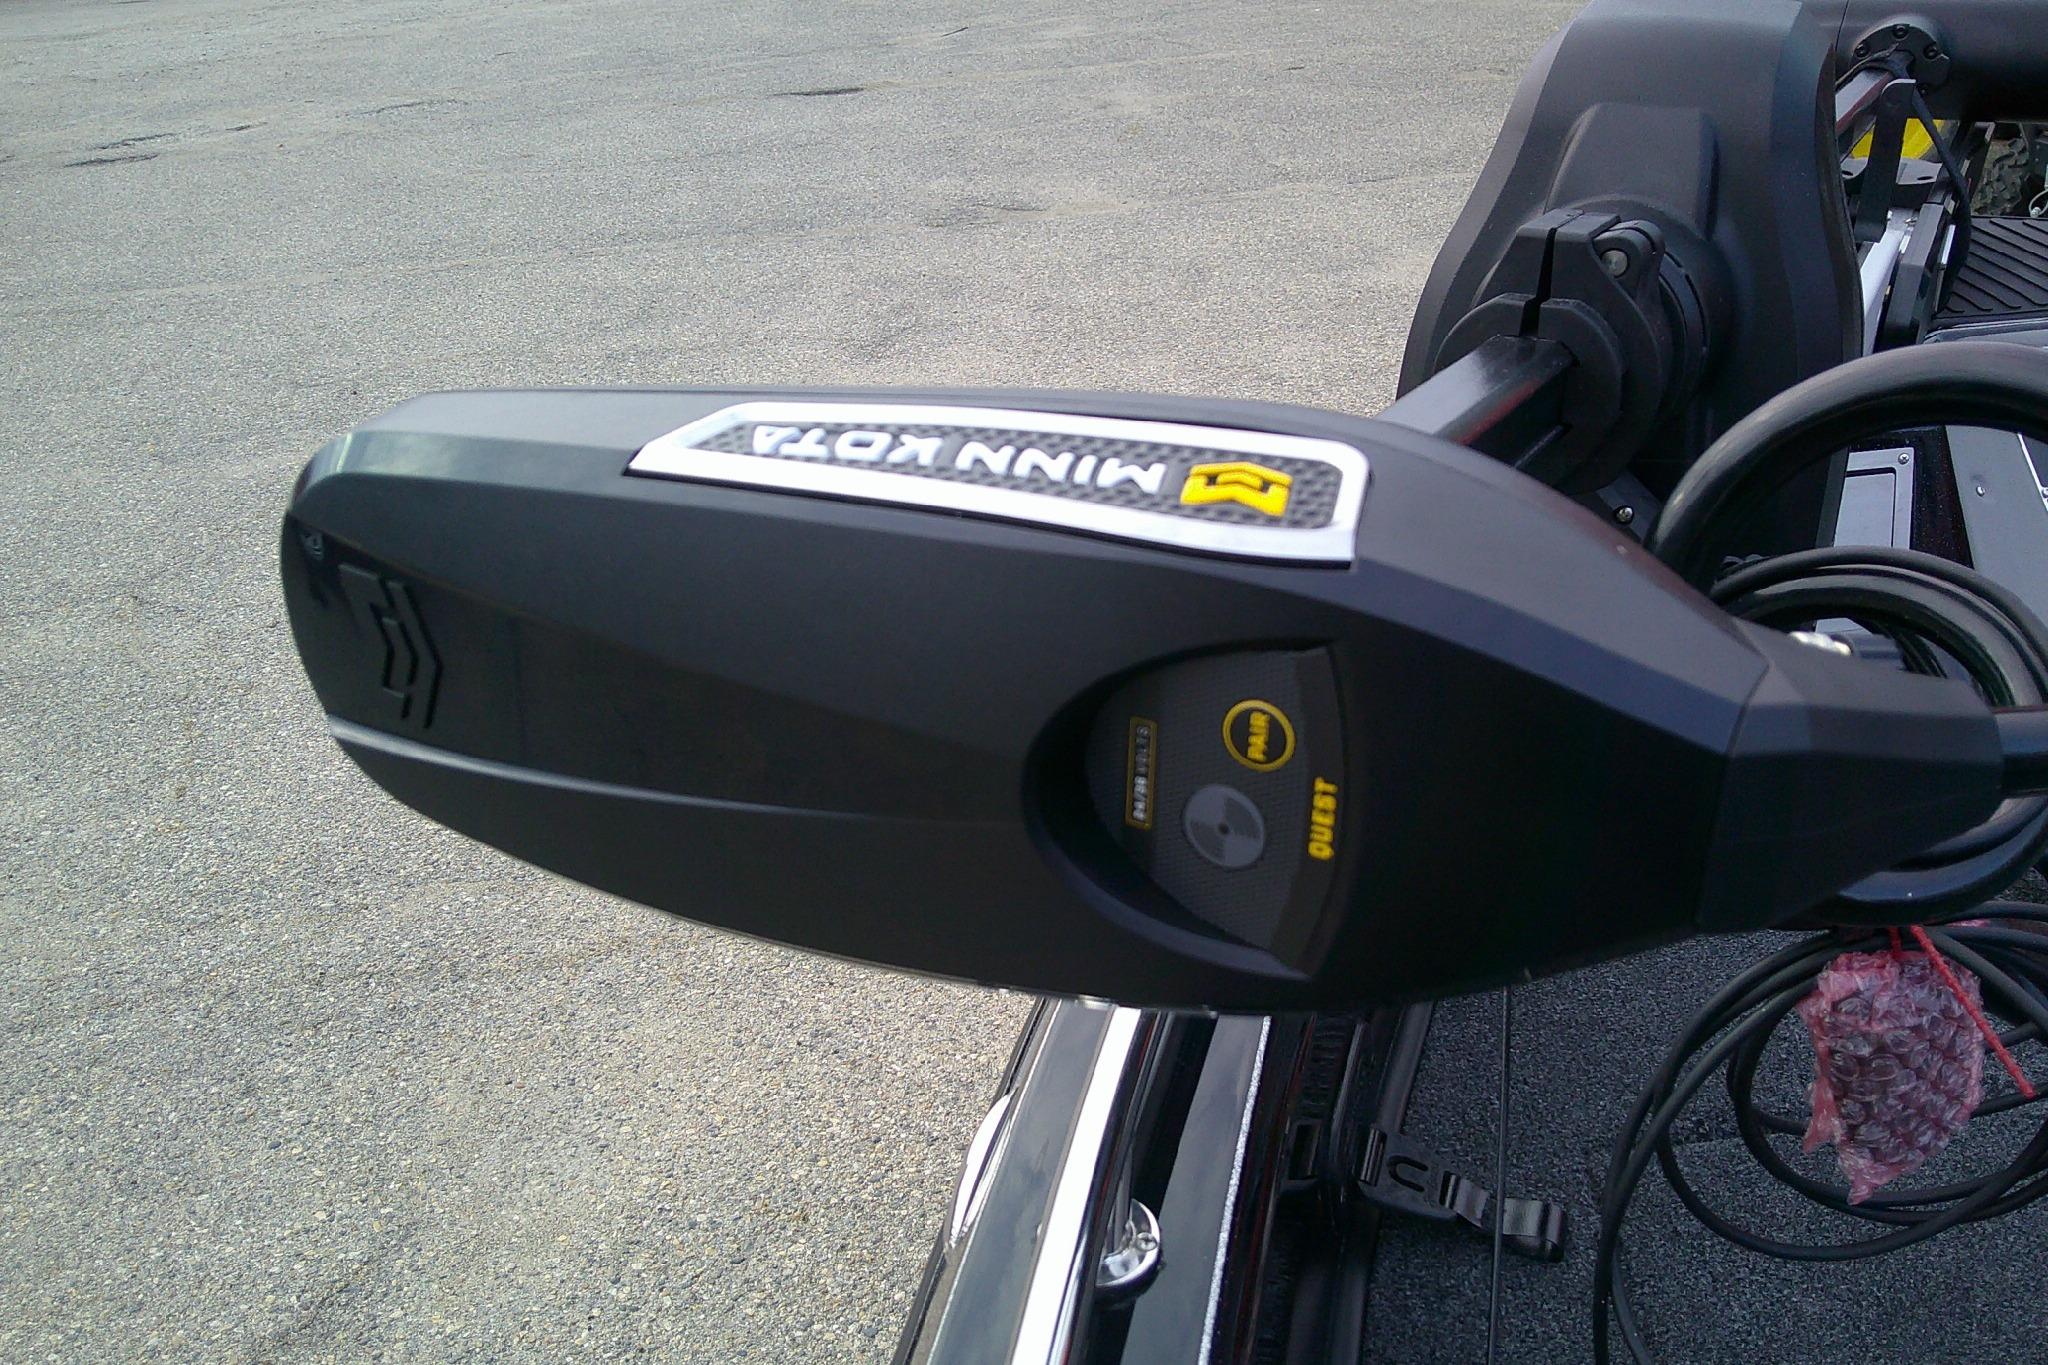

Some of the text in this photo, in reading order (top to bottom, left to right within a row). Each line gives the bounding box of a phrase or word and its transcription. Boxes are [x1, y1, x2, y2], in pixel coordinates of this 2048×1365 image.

[752, 425, 1166, 494] MINN KOTA
[1248, 711, 1270, 762] PAIR
[1308, 777, 1338, 860] QUEST
